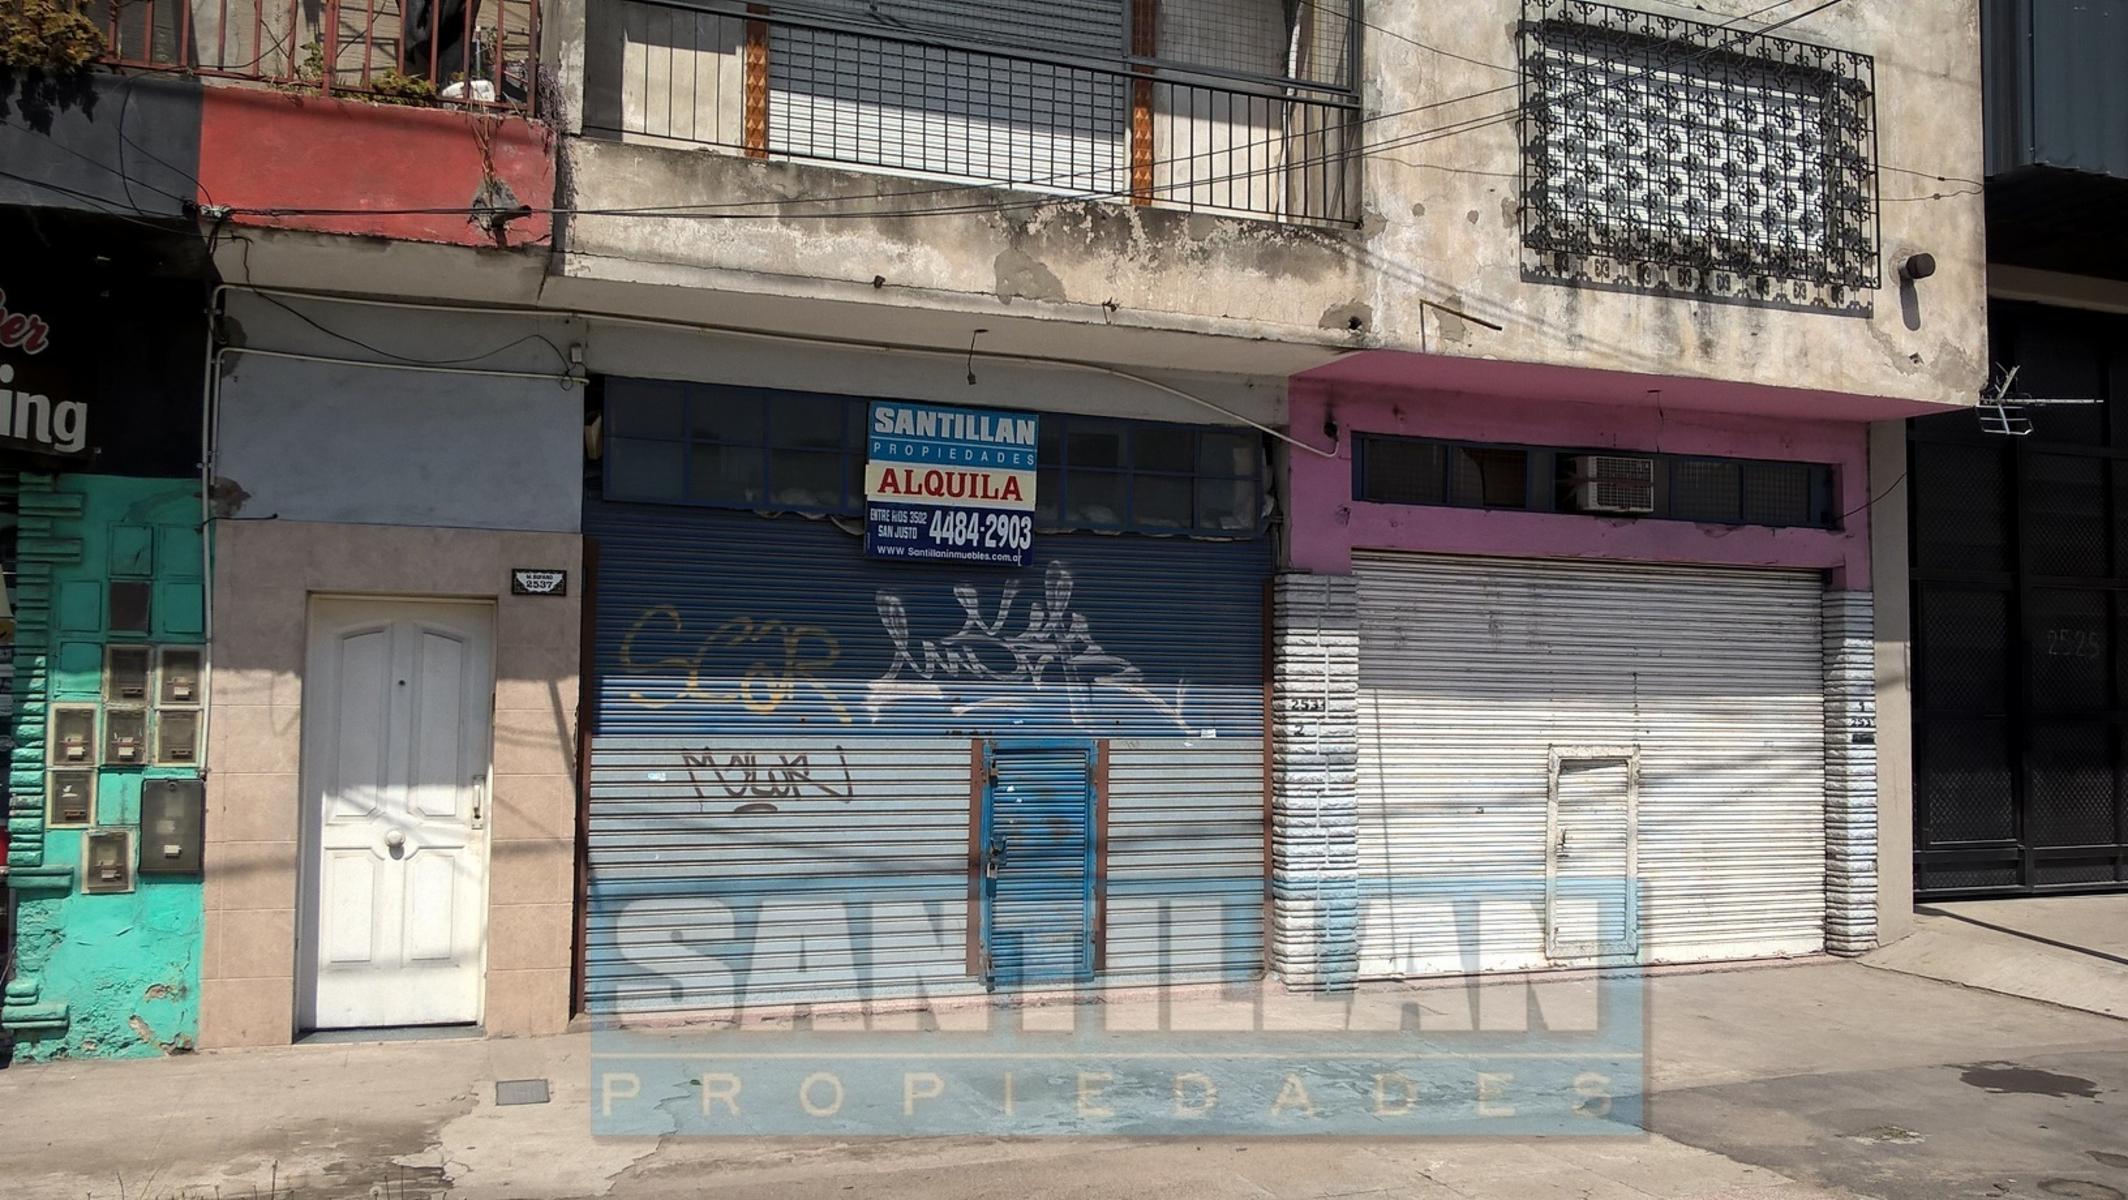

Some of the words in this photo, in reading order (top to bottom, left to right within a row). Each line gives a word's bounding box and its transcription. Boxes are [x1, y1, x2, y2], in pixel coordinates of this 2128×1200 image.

[0, 290, 49, 355] er
[874, 406, 1036, 446] SANTILLAN
[873, 441, 1035, 466] PROPIEDADES
[877, 467, 1024, 502] ALQUILA
[870, 508, 890, 522] ENTRE
[928, 509, 1032, 550] 4484-2903
[878, 524, 894, 537] SAN
[894, 526, 918, 540] JUSTO
[526, 580, 554, 589] 2537
